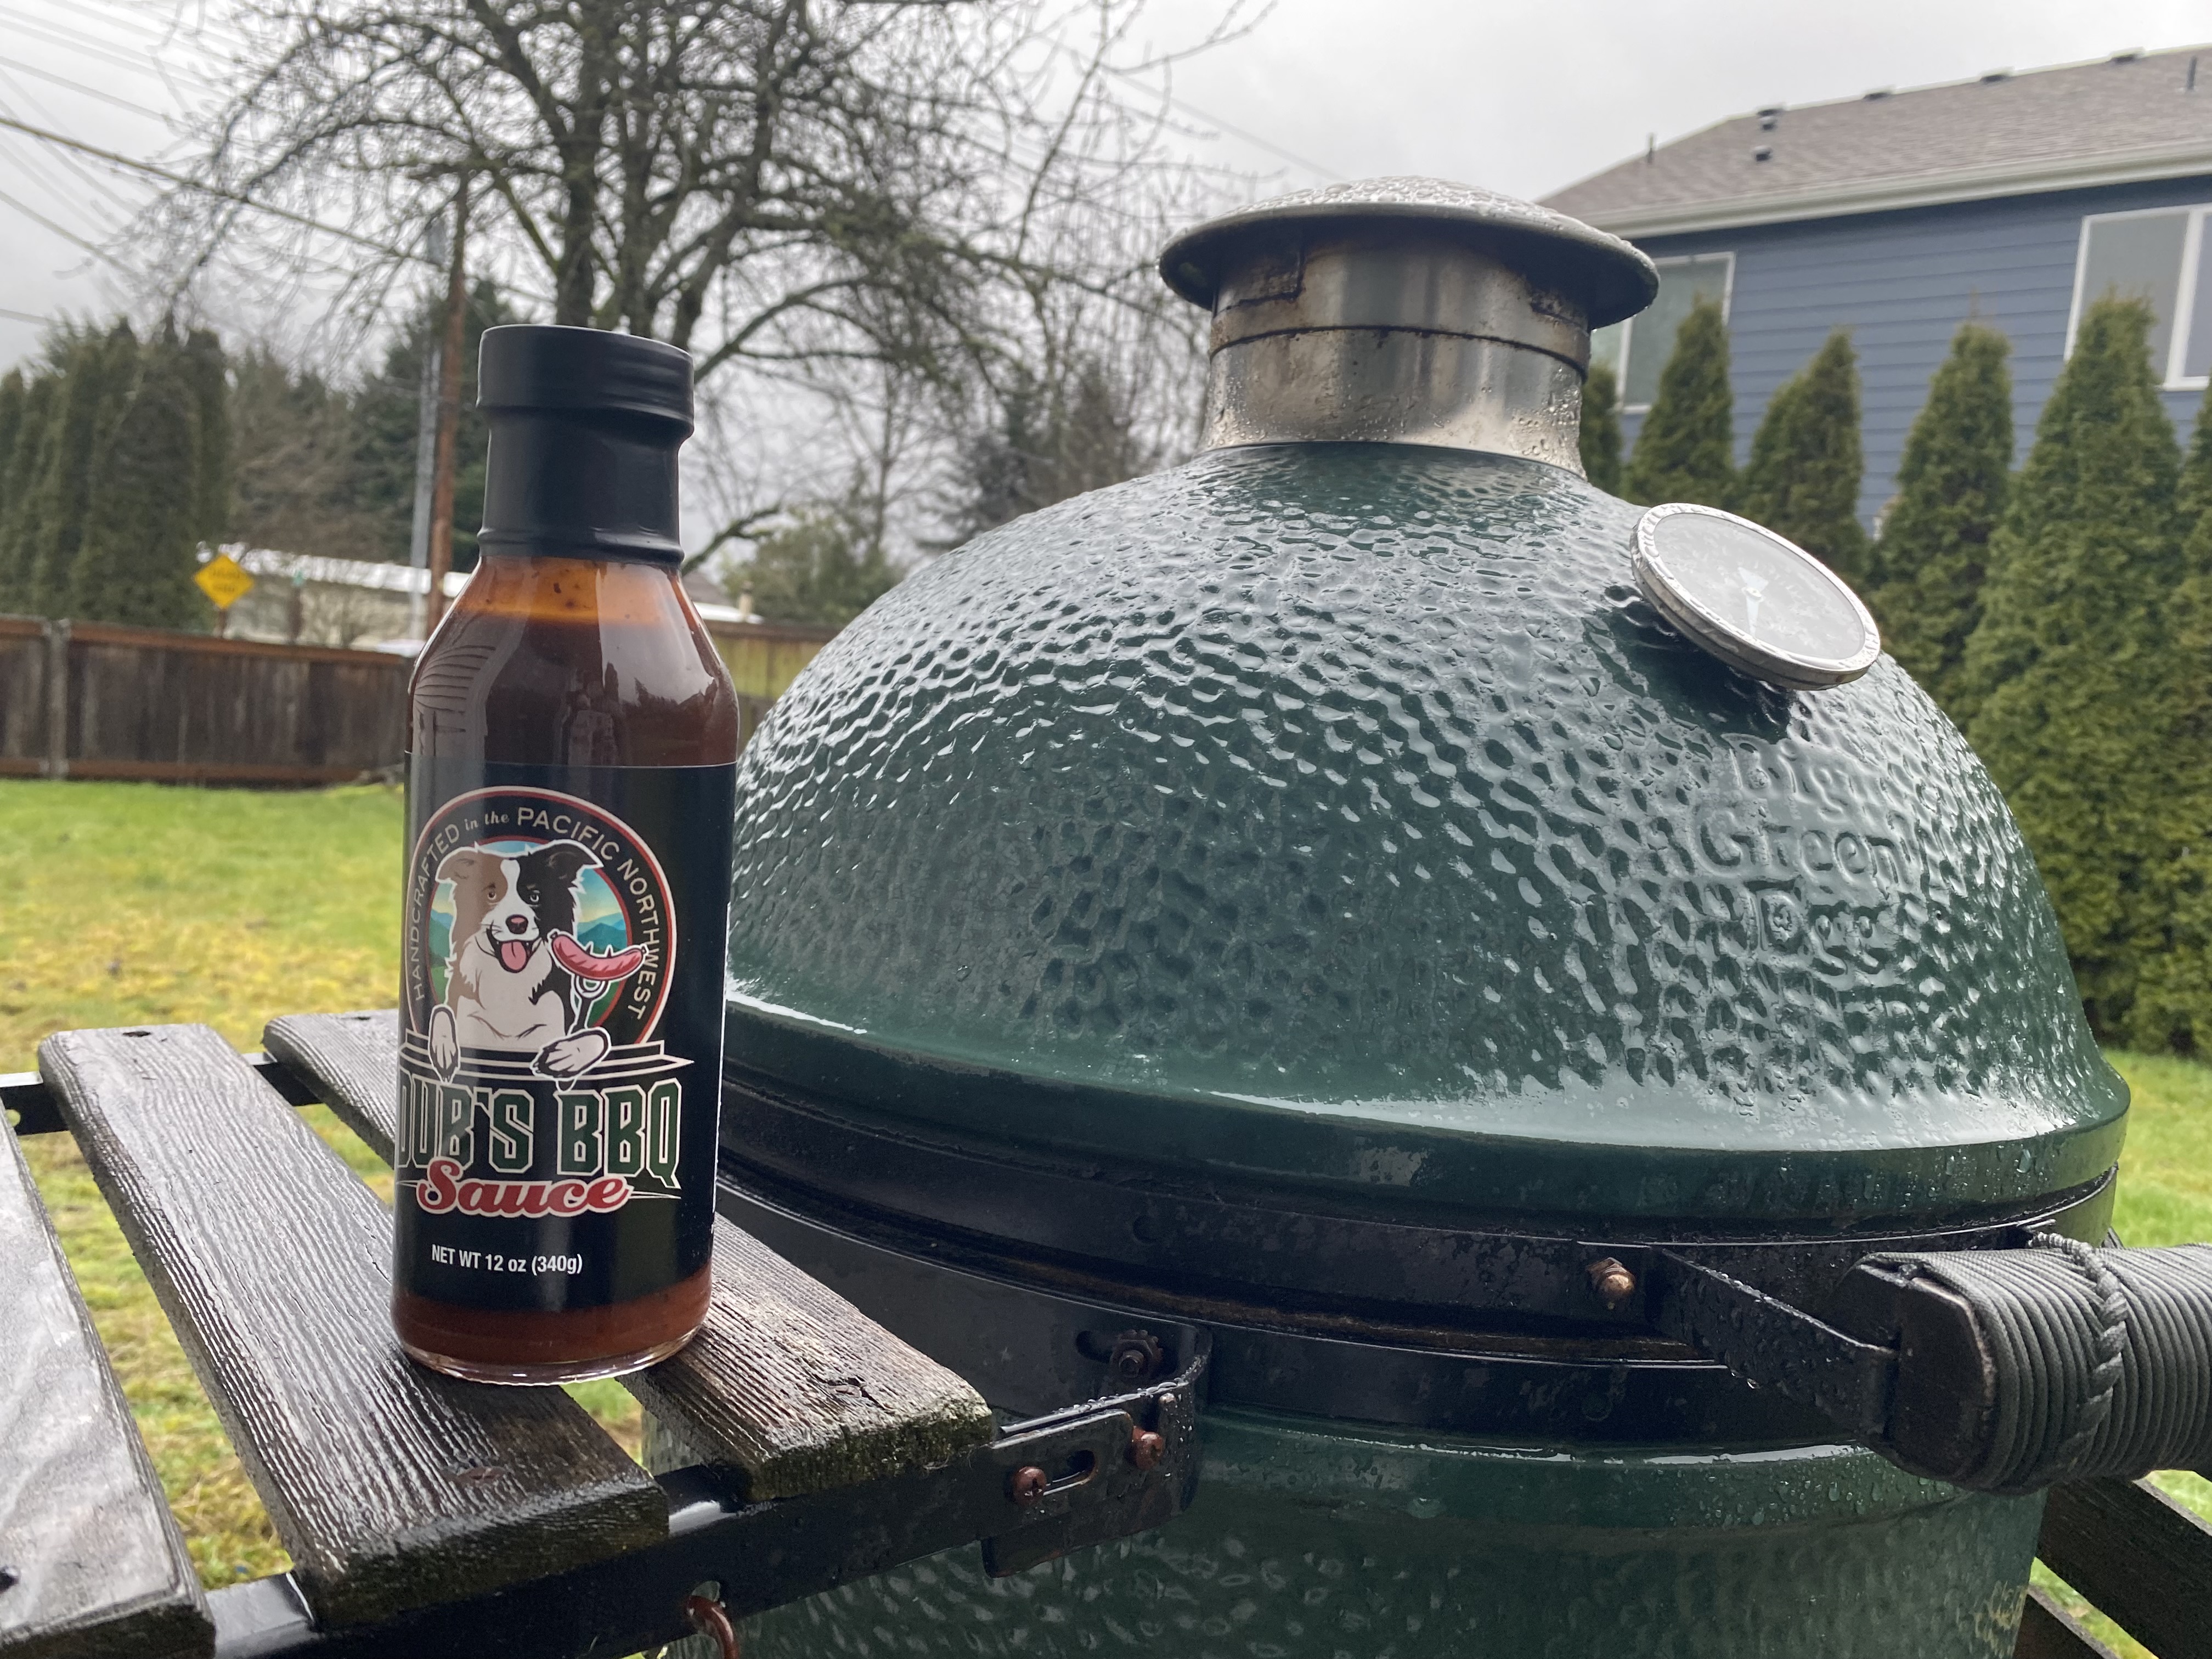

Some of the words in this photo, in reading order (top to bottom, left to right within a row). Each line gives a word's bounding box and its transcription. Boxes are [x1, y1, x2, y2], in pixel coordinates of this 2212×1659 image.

[411, 823, 460, 1001] HANDCRAFTED
[464, 819, 479, 831] in
[484, 811, 510, 825] the
[517, 806, 620, 861] PACIFIC
[617, 858, 660, 1020] NORTHWEST
[553, 1077, 682, 1190] BBQ
[416, 1155, 634, 1218] Sauce
[432, 1244, 456, 1265] NET
[459, 1249, 481, 1269] WT
[485, 1254, 504, 1272] 12
[508, 1259, 526, 1272] oz
[532, 1253, 582, 1276] (340g)
